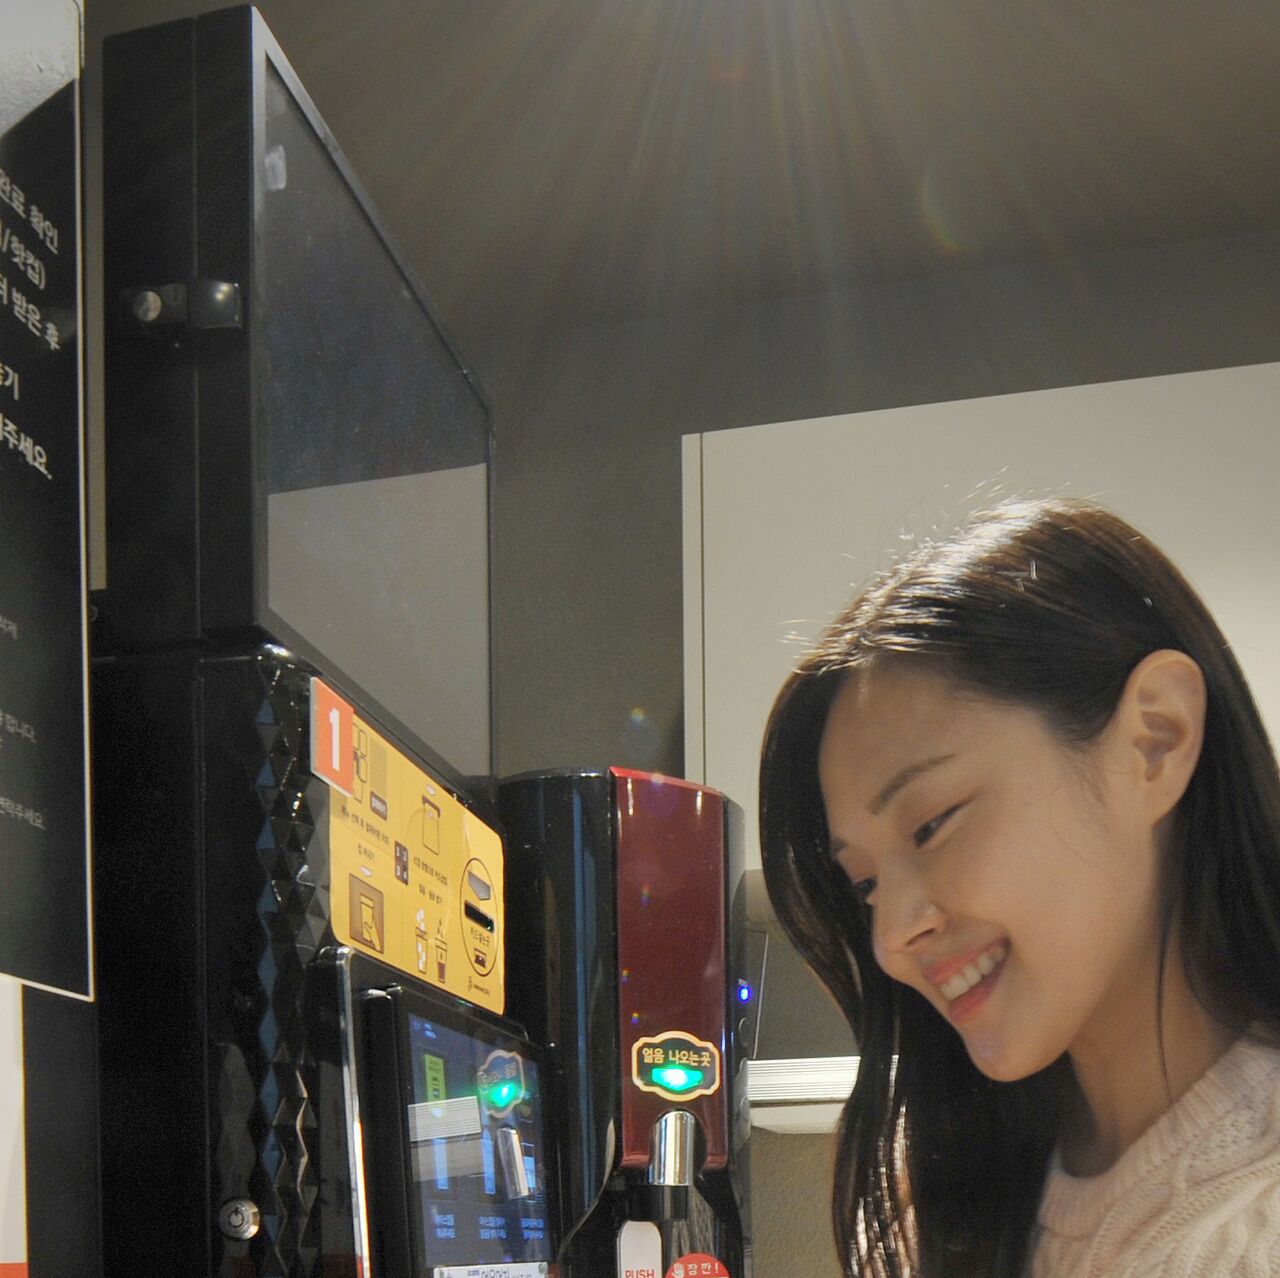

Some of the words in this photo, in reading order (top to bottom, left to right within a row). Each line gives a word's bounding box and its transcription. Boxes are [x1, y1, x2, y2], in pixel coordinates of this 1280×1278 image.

[11, 285, 42, 338] 받은
[328, 705, 341, 772] 1
[642, 1046, 665, 1066] 얼음
[668, 1048, 712, 1069] 나오는곳
